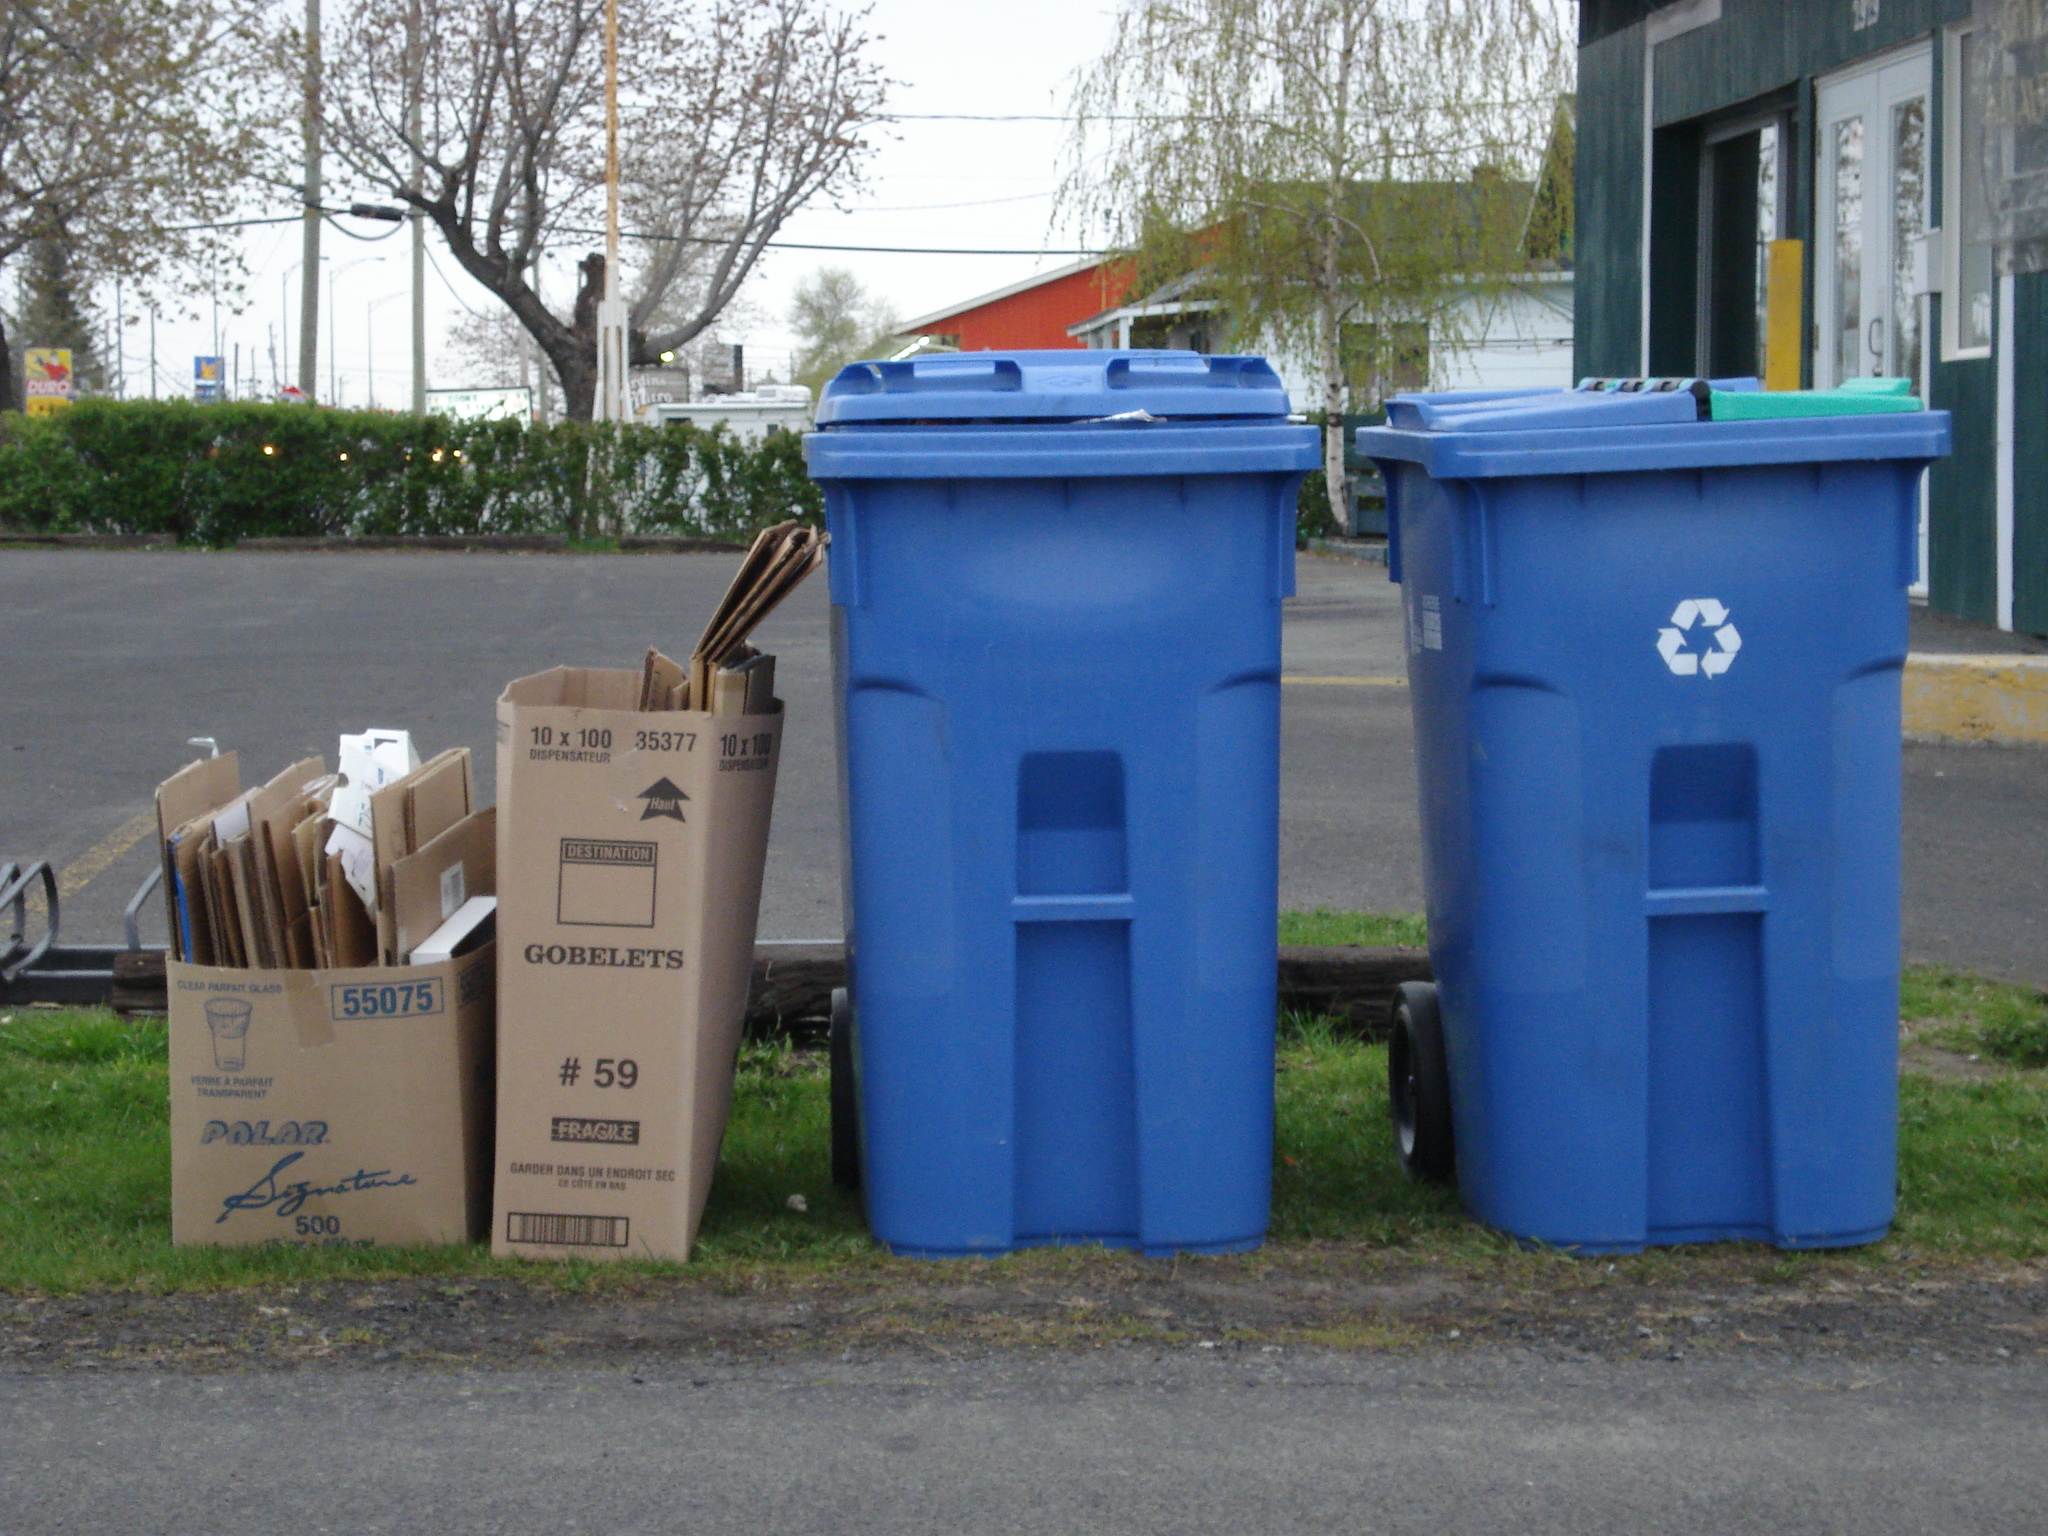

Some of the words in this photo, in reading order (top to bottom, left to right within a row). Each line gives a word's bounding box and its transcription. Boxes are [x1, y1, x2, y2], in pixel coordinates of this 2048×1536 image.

[530, 726, 552, 746] 10
[560, 731, 570, 747] x
[578, 728, 612, 749] 100
[635, 730, 697, 752] 35377
[720, 733, 737, 757] 10
[740, 739, 749, 756] x
[529, 748, 611, 763] DISPENSATEUR
[566, 844, 651, 861] DESTINATION
[524, 944, 684, 970] GOBELETS
[207, 982, 245, 992] PARFAIT
[343, 983, 433, 1016] 55075
[558, 1057, 581, 1086] #
[594, 1058, 639, 1089] 59
[197, 1088, 267, 1099] TRANSPARENT
[201, 1120, 328, 1145] POLAR
[558, 1121, 634, 1142] FRAGILE
[510, 1161, 553, 1176] GARDER
[556, 1164, 585, 1178] DANS
[588, 1165, 603, 1178] UN
[606, 1167, 652, 1181] ENDROIT
[655, 1169, 675, 1182] SEC
[215, 1151, 417, 1224] Signature
[295, 1215, 341, 1235] 500
